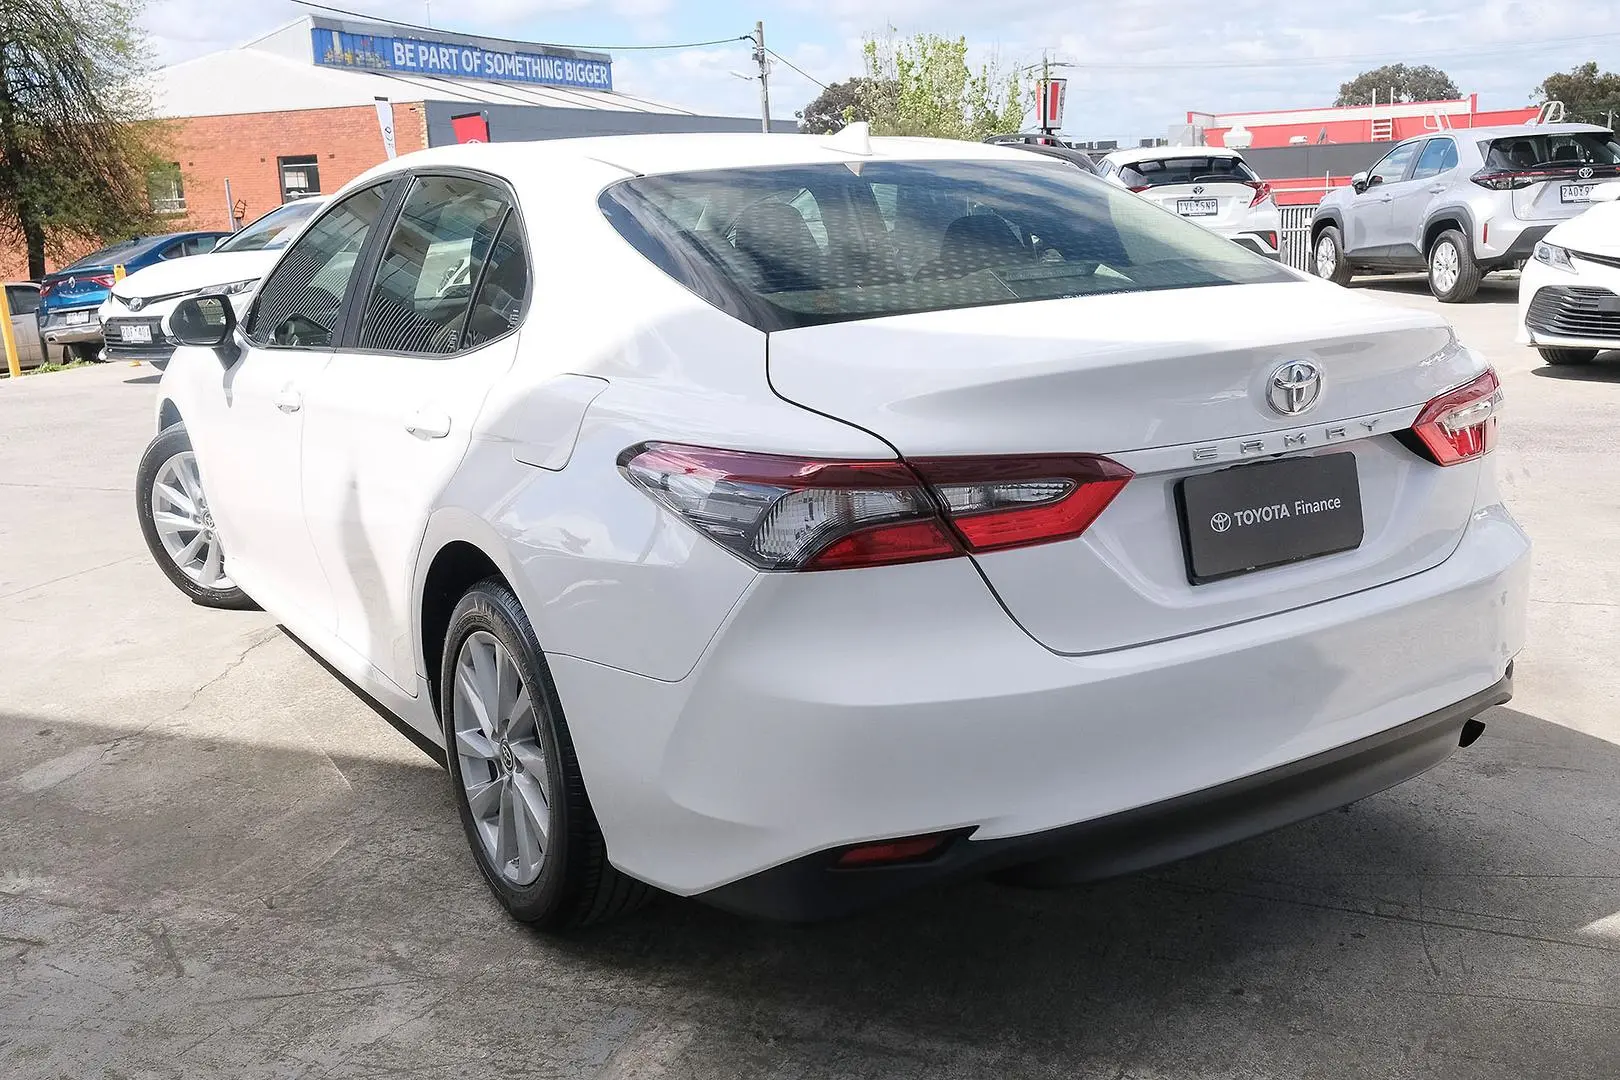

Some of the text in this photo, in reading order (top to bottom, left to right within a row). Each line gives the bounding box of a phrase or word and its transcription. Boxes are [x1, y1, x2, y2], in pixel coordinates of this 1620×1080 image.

[393, 41, 609, 85] BE PART OF SOMETHING BIGGER
[1233, 497, 1342, 527] TOYOTA Finance
